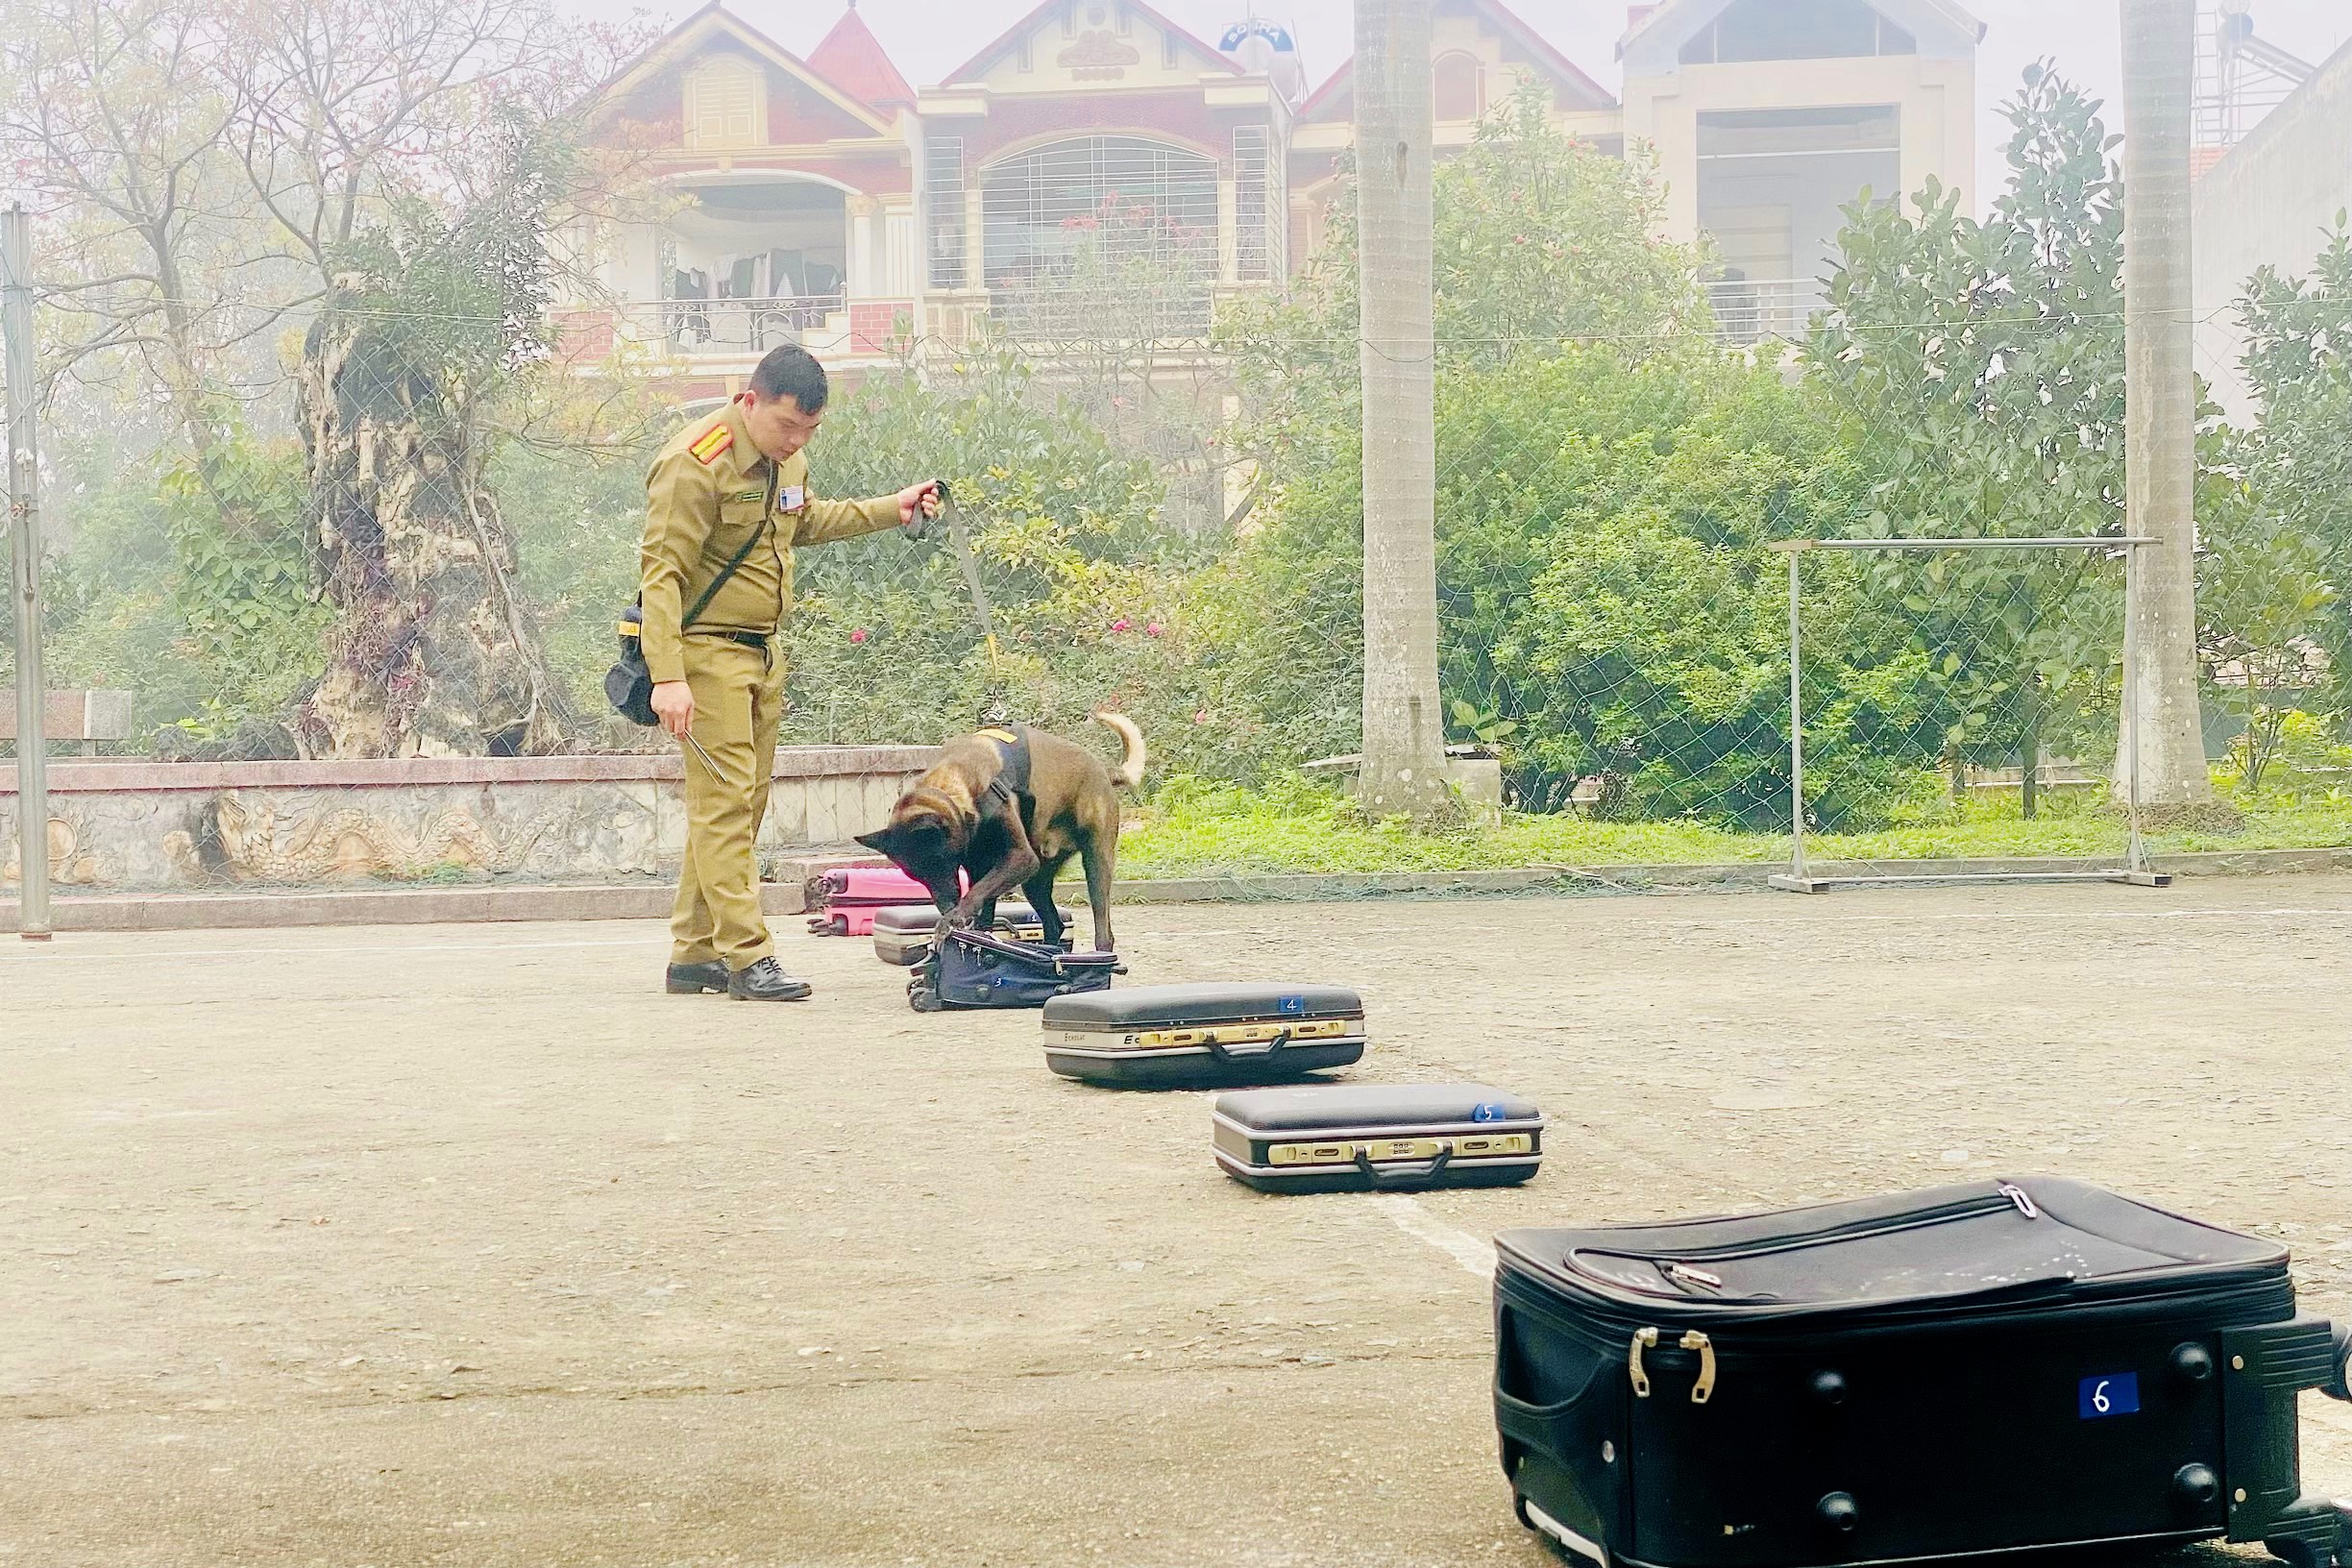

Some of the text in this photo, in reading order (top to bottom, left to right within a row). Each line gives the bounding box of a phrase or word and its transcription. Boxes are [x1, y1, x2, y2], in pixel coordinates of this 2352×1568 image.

[994, 977, 1002, 988] 3
[1286, 999, 1298, 1011] 4
[1483, 1105, 1494, 1120] 5
[2093, 1380, 2110, 1412] 6
